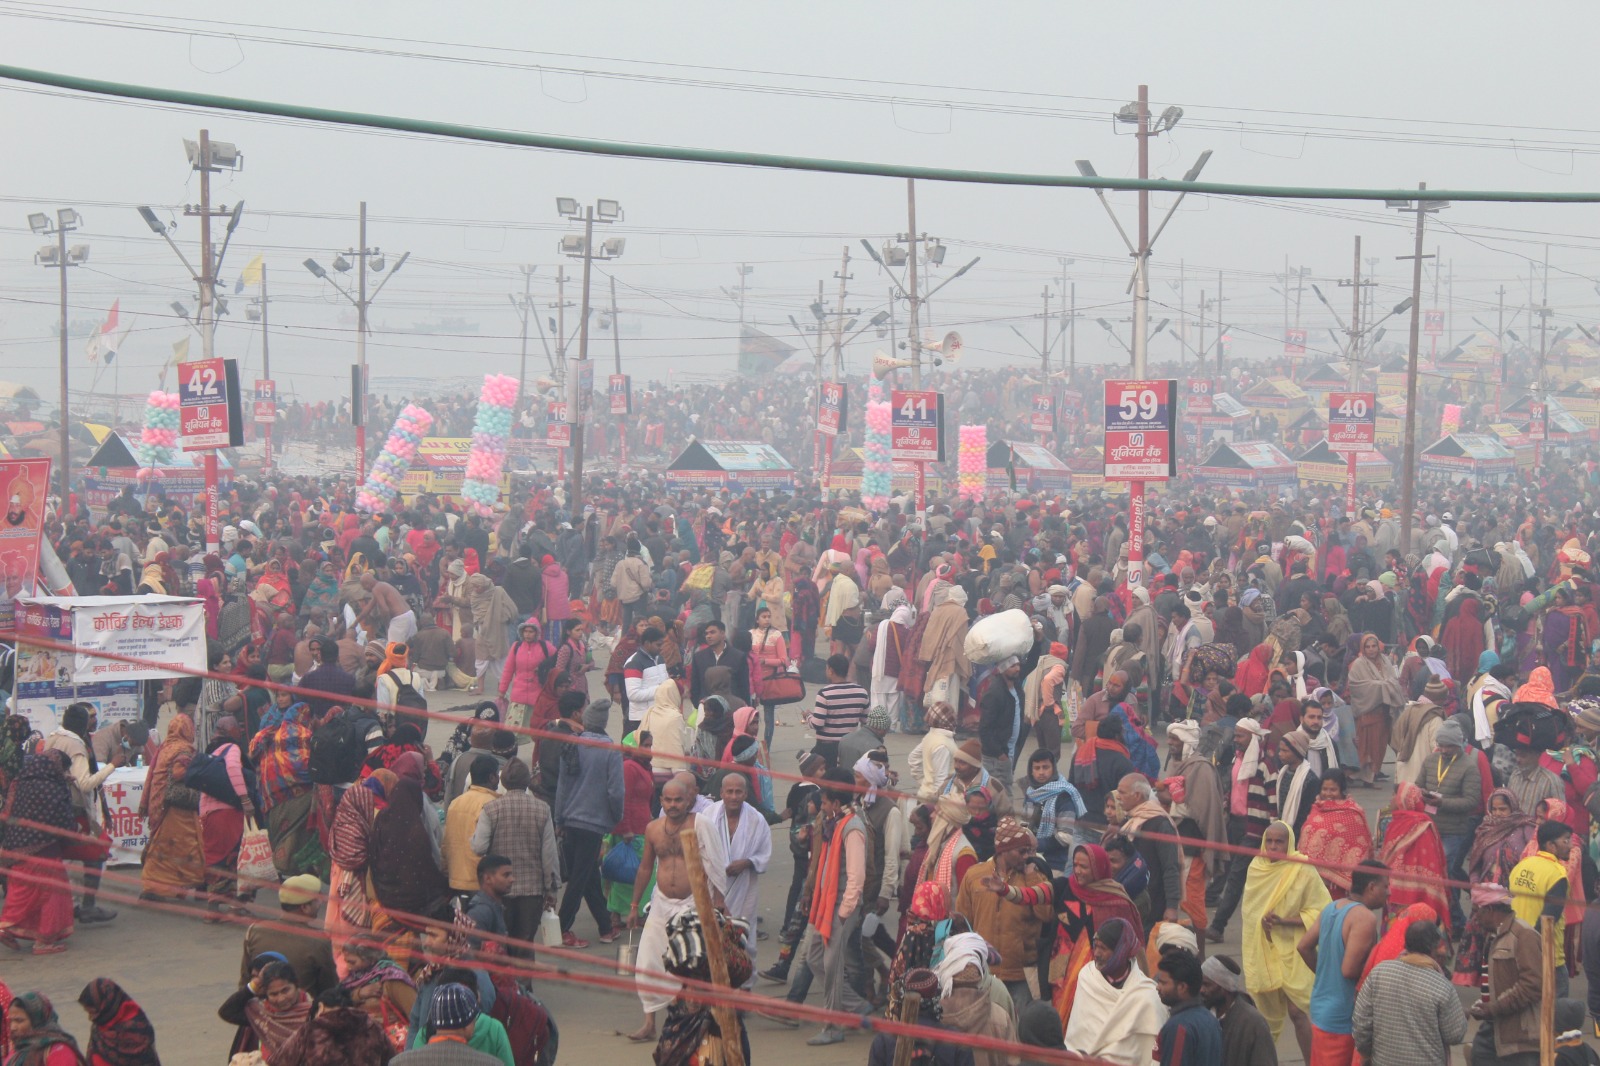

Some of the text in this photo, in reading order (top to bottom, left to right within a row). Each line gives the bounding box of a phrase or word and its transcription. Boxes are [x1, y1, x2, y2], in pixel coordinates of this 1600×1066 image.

[1429, 312, 1441, 320] 72
[1290, 332, 1303, 342] 73
[188, 368, 218, 396] 42
[612, 378, 622, 391] 77
[1192, 382, 1208, 394] 80
[259, 384, 271, 398] 15
[826, 388, 838, 406] 38
[900, 398, 927, 420] 41
[1037, 398, 1050, 410] 79
[1118, 390, 1158, 420] 59
[1338, 400, 1367, 418] 40
[552, 406, 566, 420] 16
[1532, 406, 1542, 418] 92
[184, 418, 209, 432] यूनियन
[896, 436, 920, 447] यूनियन
[1332, 432, 1356, 440] यूनियन
[1110, 444, 1162, 460] यूनियन बैंक
[207, 484, 218, 517] यूनियन
[1132, 495, 1143, 552] यूनियन बैंक
[92, 611, 183, 631] कोविड हेल्प डेस्क
[122, 835, 150, 847] माघ मे
